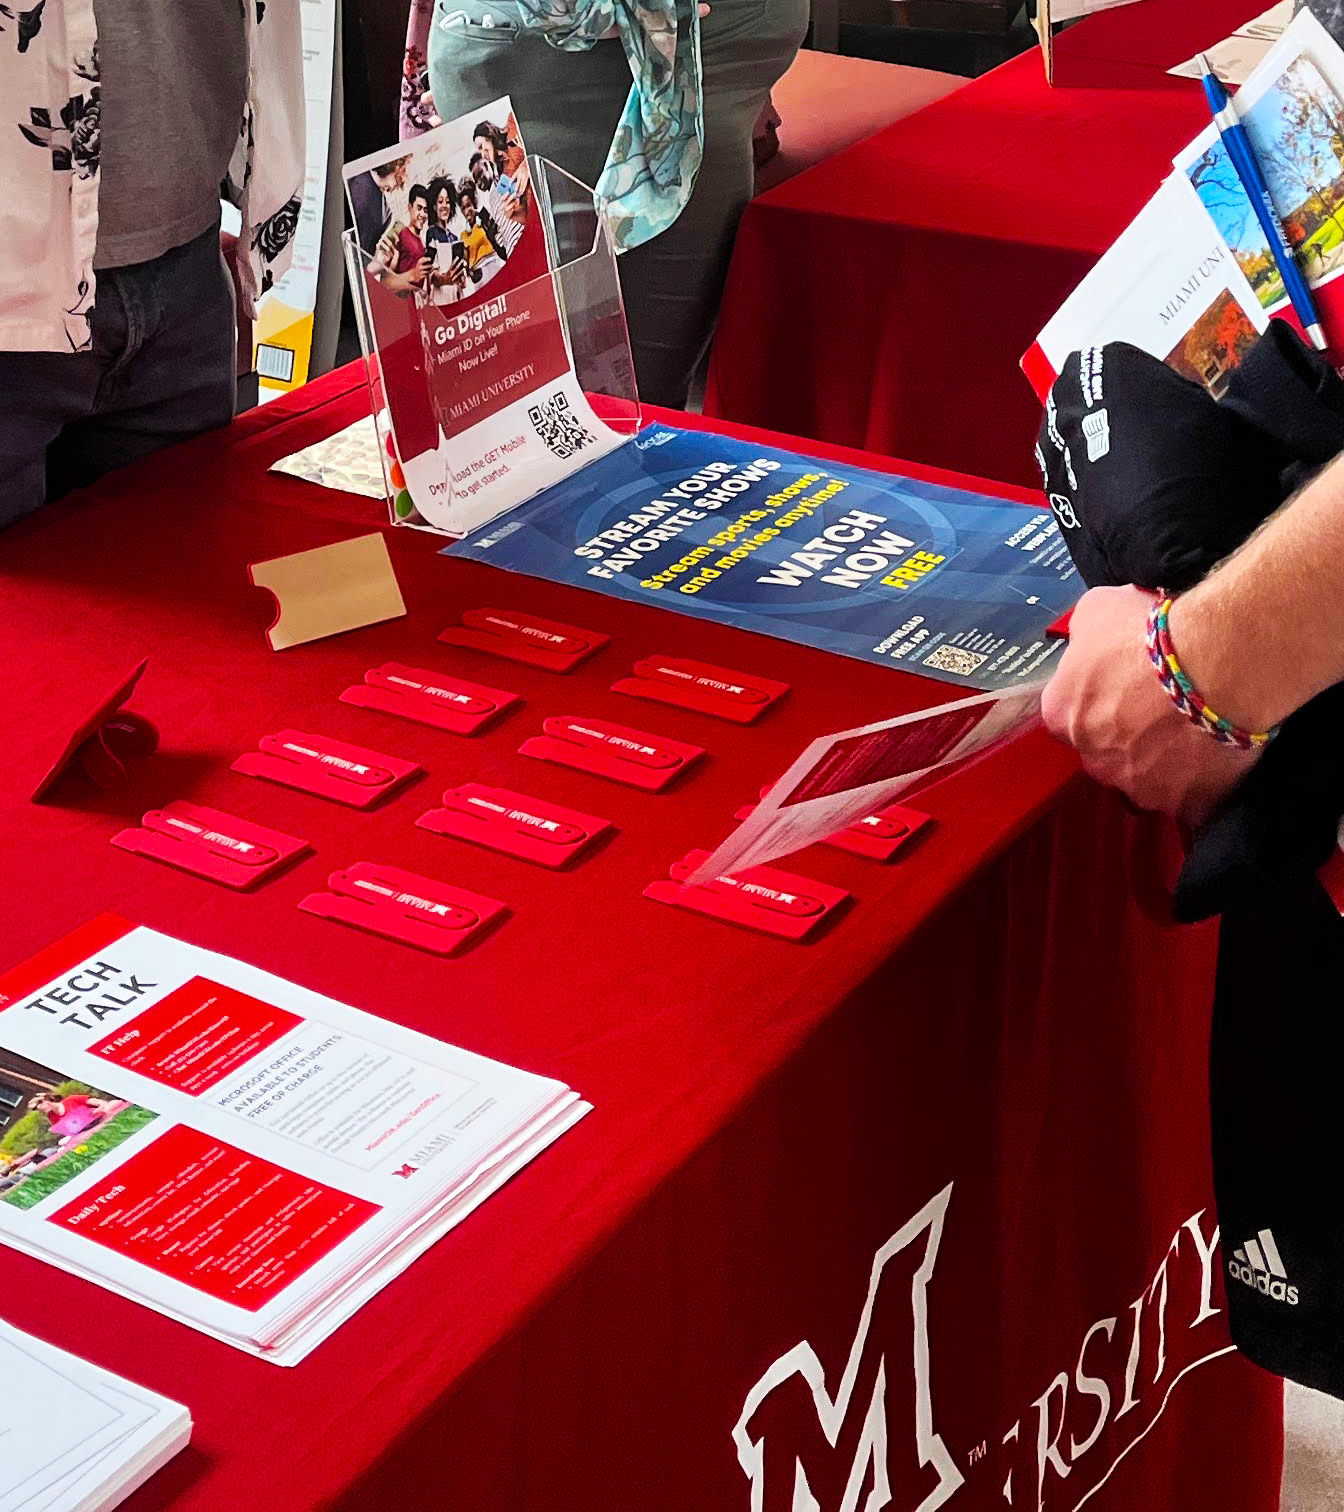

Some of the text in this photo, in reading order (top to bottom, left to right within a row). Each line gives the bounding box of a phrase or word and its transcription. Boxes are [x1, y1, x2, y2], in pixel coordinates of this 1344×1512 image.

[434, 296, 508, 346] Go Digital!
[1158, 279, 1202, 327] MIAMI
[436, 309, 531, 366] Miami ID on Your Phone
[458, 343, 499, 373] Now Live!
[449, 363, 536, 421] MIAMI UNIVERSITY
[471, 458, 485, 471] the
[484, 449, 499, 464] GET
[500, 434, 527, 455] Mobile
[468, 481, 481, 495] get
[573, 498, 677, 560] STREAM
[661, 460, 738, 501] YOUR
[586, 507, 707, 580] FAVORITE
[695, 457, 782, 512] SHOWS
[639, 471, 829, 590] Stream sports, shows,
[679, 478, 851, 595] and movies anytime!
[756, 508, 889, 589] WATCH
[819, 529, 917, 590] NOW
[879, 549, 947, 590] FREE
[872, 615, 926, 655] DOWNLOAD
[890, 639, 916, 660] FREE
[913, 628, 931, 645] APP
[23, 960, 123, 1015] TECH
[58, 974, 159, 1031] TALK
[114, 1028, 141, 1047] Help
[218, 1069, 272, 1107] MICROSOFT
[270, 1044, 305, 1071] OFFICE
[234, 1077, 284, 1113] AVAILABLE
[283, 1066, 299, 1080] TO
[297, 1034, 343, 1068] STUDENTS
[246, 1102, 270, 1119] FREE
[285, 1063, 325, 1092] CHARGE
[67, 1183, 127, 1226] Daily Tech
[1227, 1255, 1299, 1306] adidas
